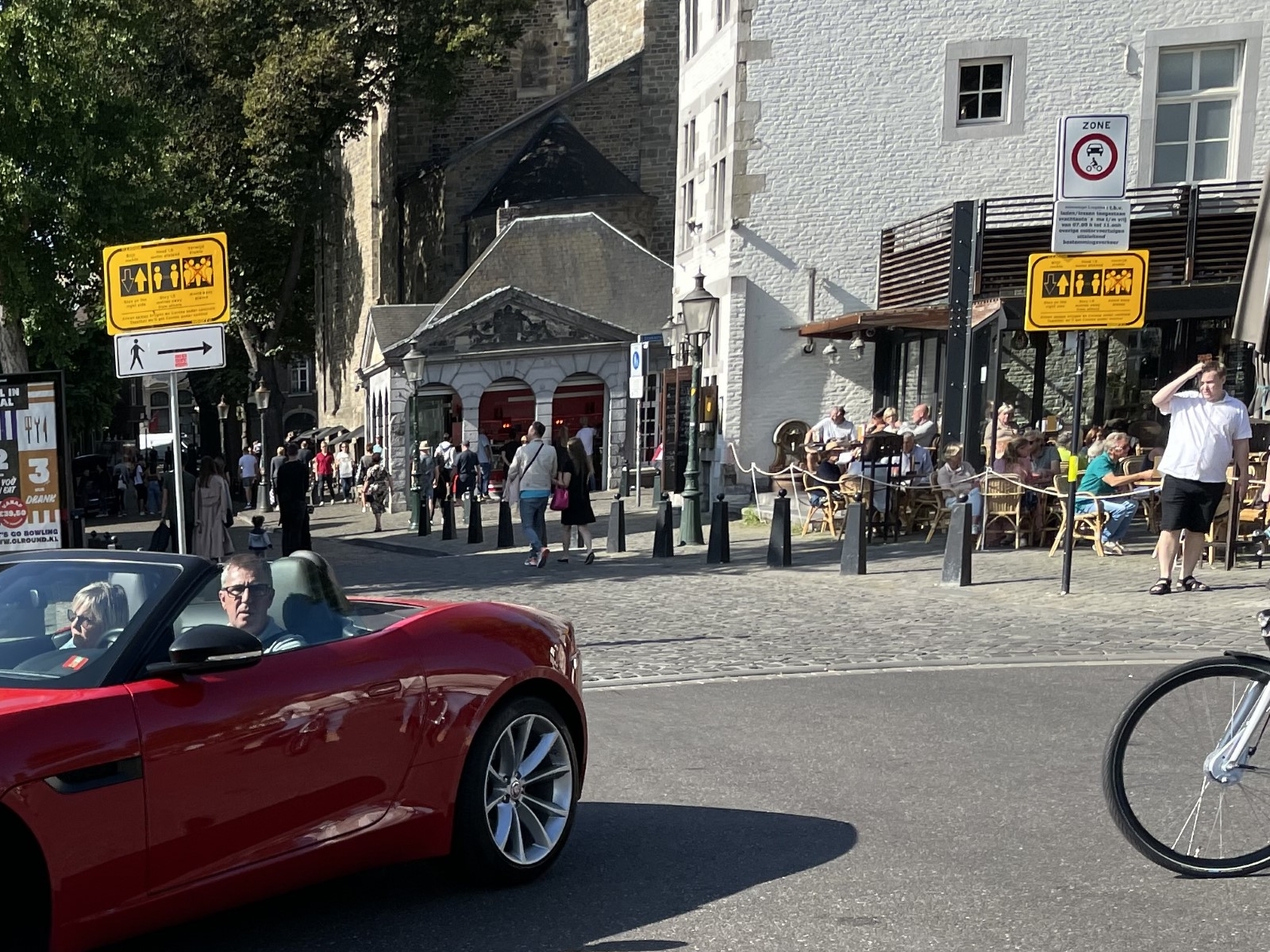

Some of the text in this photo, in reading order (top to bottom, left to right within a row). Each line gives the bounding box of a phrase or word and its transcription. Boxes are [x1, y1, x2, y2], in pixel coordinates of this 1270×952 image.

[1082, 121, 1111, 130] ZONE
[8, 387, 20, 397] IN
[28, 457, 50, 484] 3
[25, 494, 57, 505] DRANK
